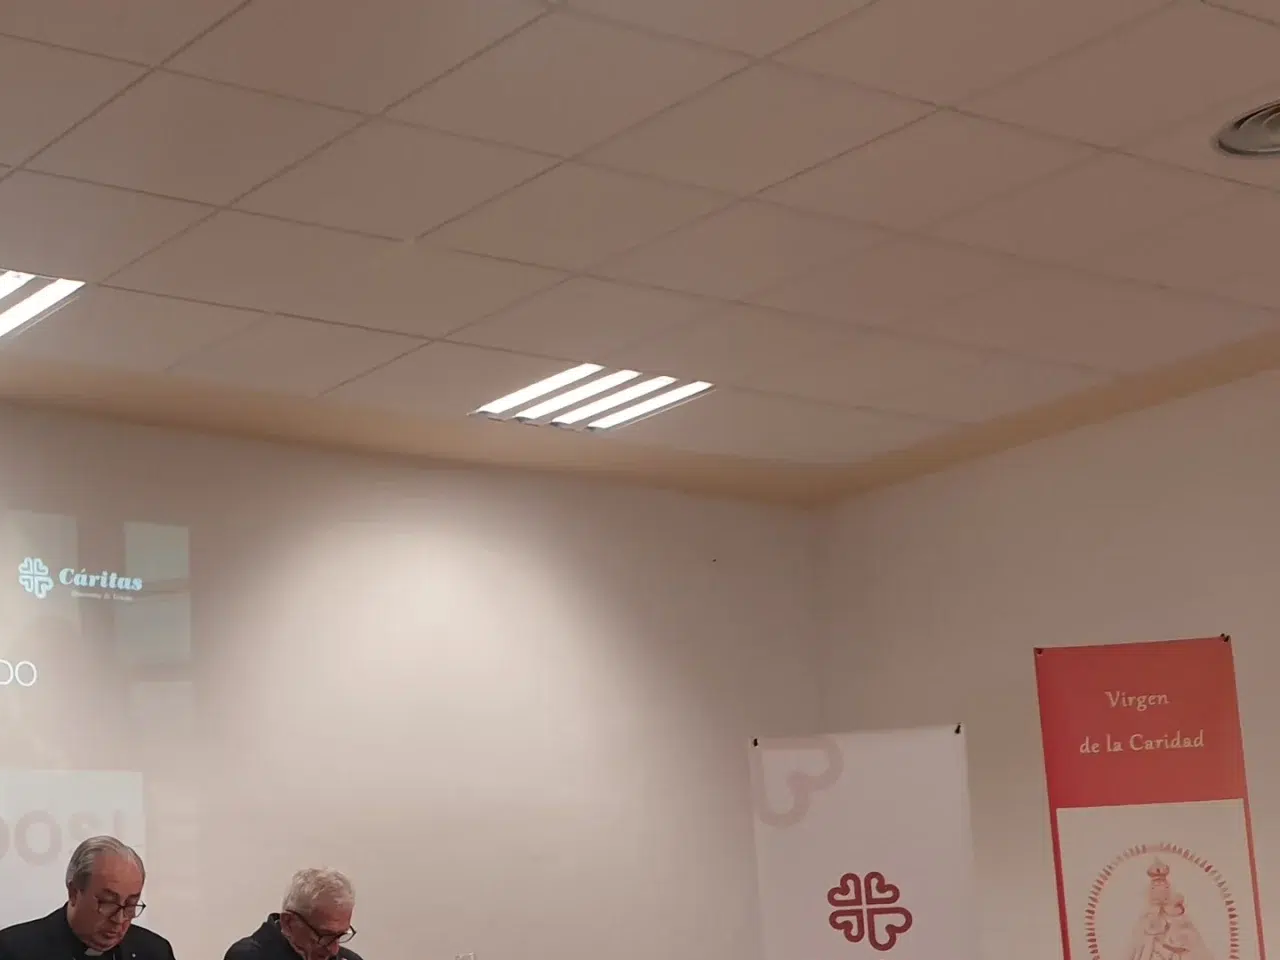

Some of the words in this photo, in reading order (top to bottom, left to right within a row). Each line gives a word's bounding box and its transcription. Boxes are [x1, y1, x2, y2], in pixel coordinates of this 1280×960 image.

[59, 567, 143, 591] Cáritas
[1104, 691, 1170, 712] Virgen
[1079, 736, 1100, 753] de
[1106, 733, 1123, 752] la
[1130, 729, 1204, 751] Caridad
